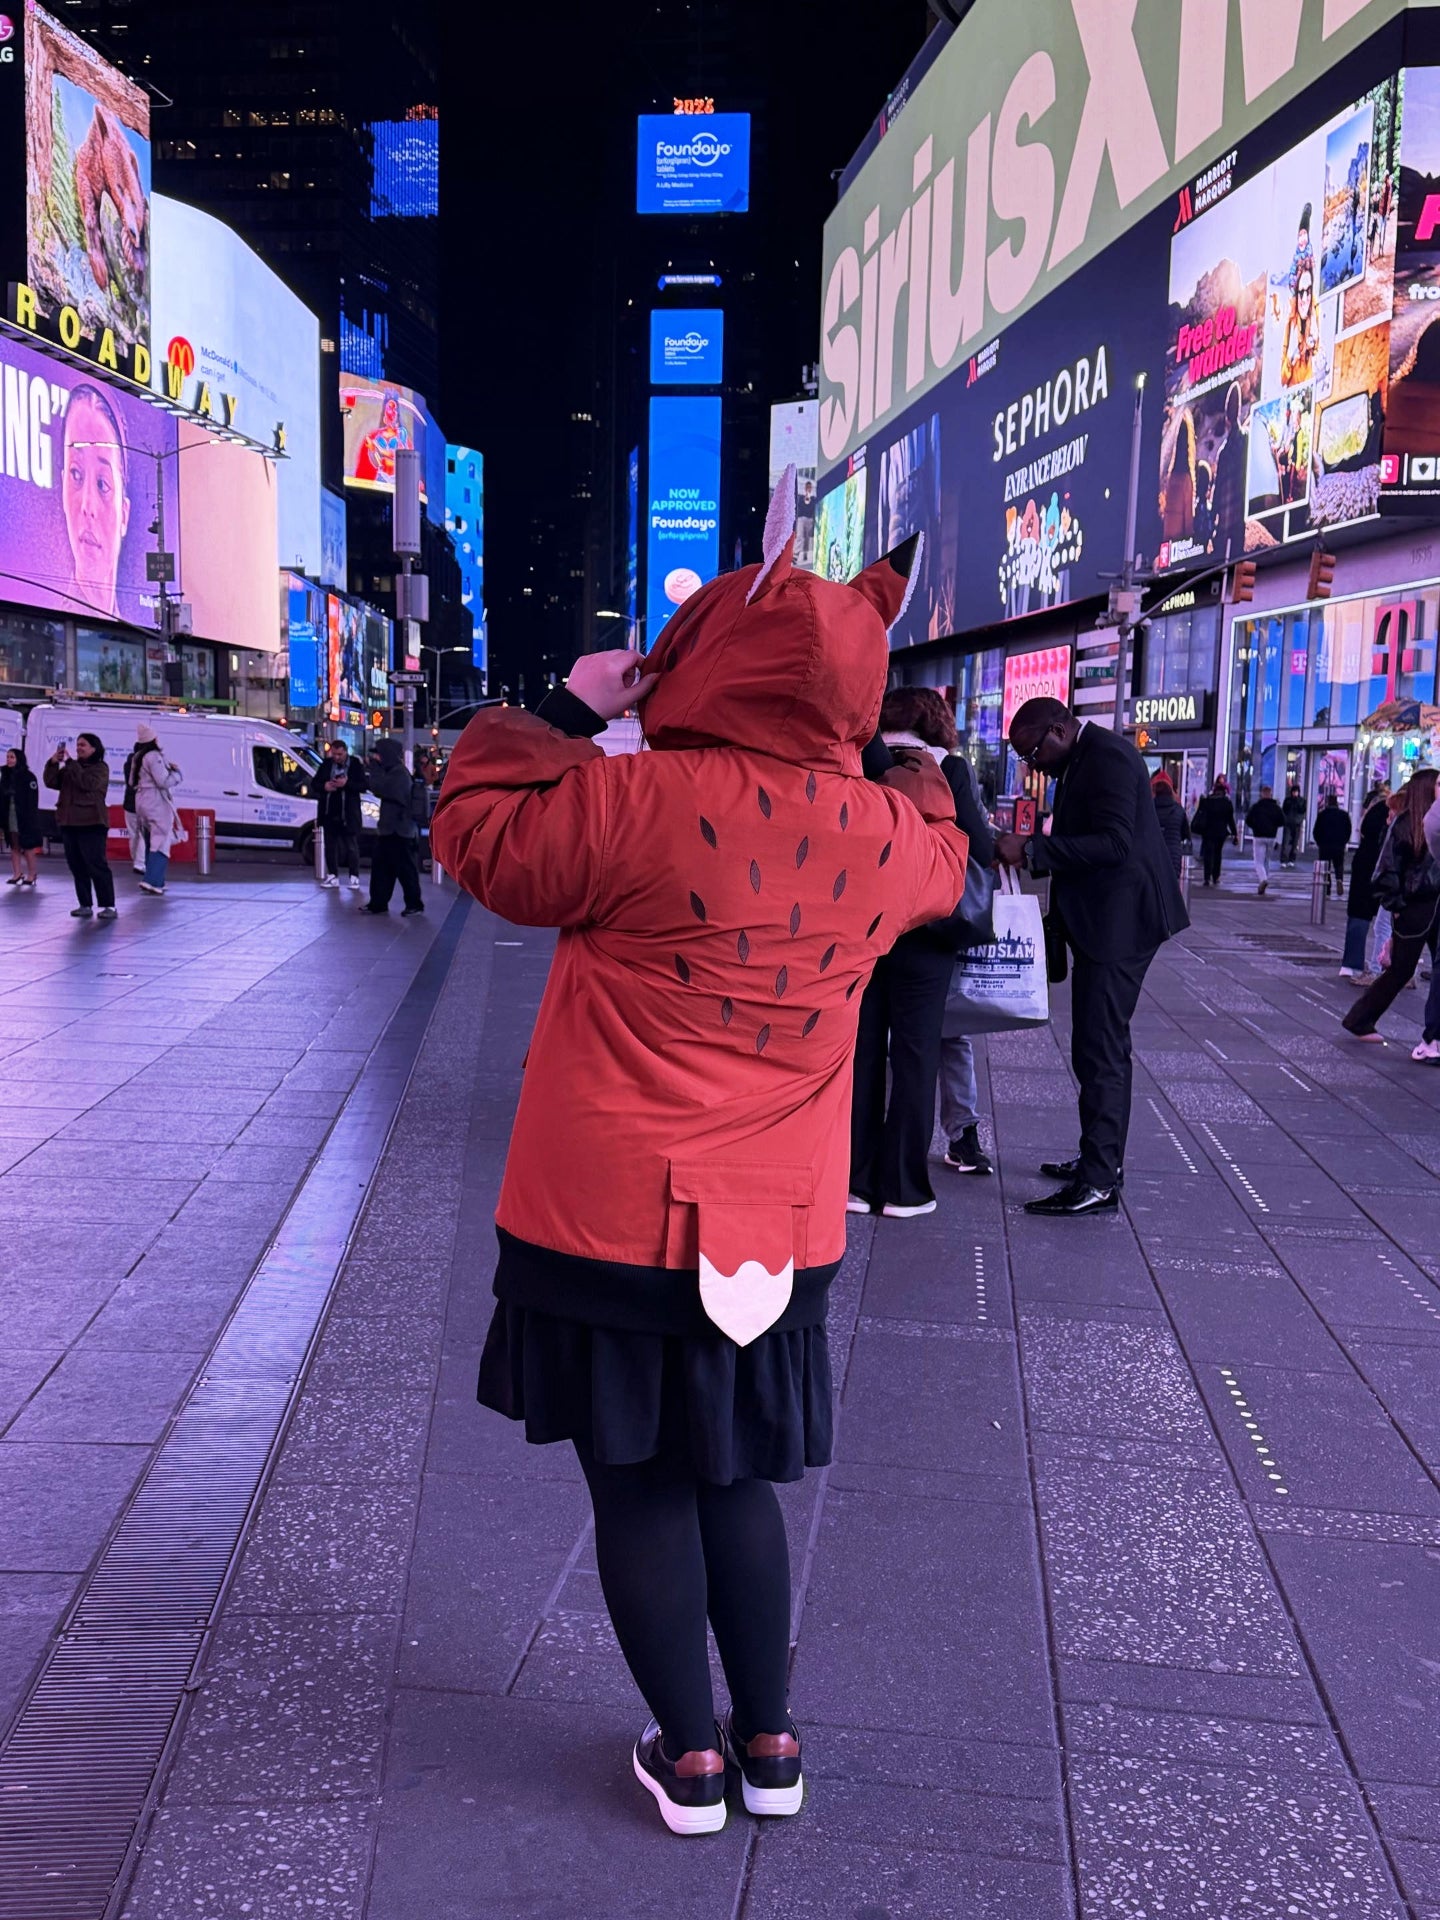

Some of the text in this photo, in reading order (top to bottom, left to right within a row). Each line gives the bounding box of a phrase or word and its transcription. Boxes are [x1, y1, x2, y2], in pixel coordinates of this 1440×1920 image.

[0, 46, 14, 63] G
[674, 97, 714, 115] 2026
[656, 140, 731, 164] Foundayo
[1196, 150, 1238, 194] MARRIOTT
[1195, 173, 1232, 212] MARQUIS
[1176, 304, 1236, 363] Free to
[201, 346, 234, 370] McDonald's
[1188, 321, 1258, 385] wander
[993, 345, 1108, 462] SEPHORA
[1004, 433, 1090, 502] ENTRANCE BELOW
[652, 500, 717, 511] APPROVED
[669, 488, 700, 499] NOW
[652, 516, 717, 532] Foundayo
[1013, 680, 1056, 705] PANDORA
[1135, 695, 1195, 724] SEPHORA
